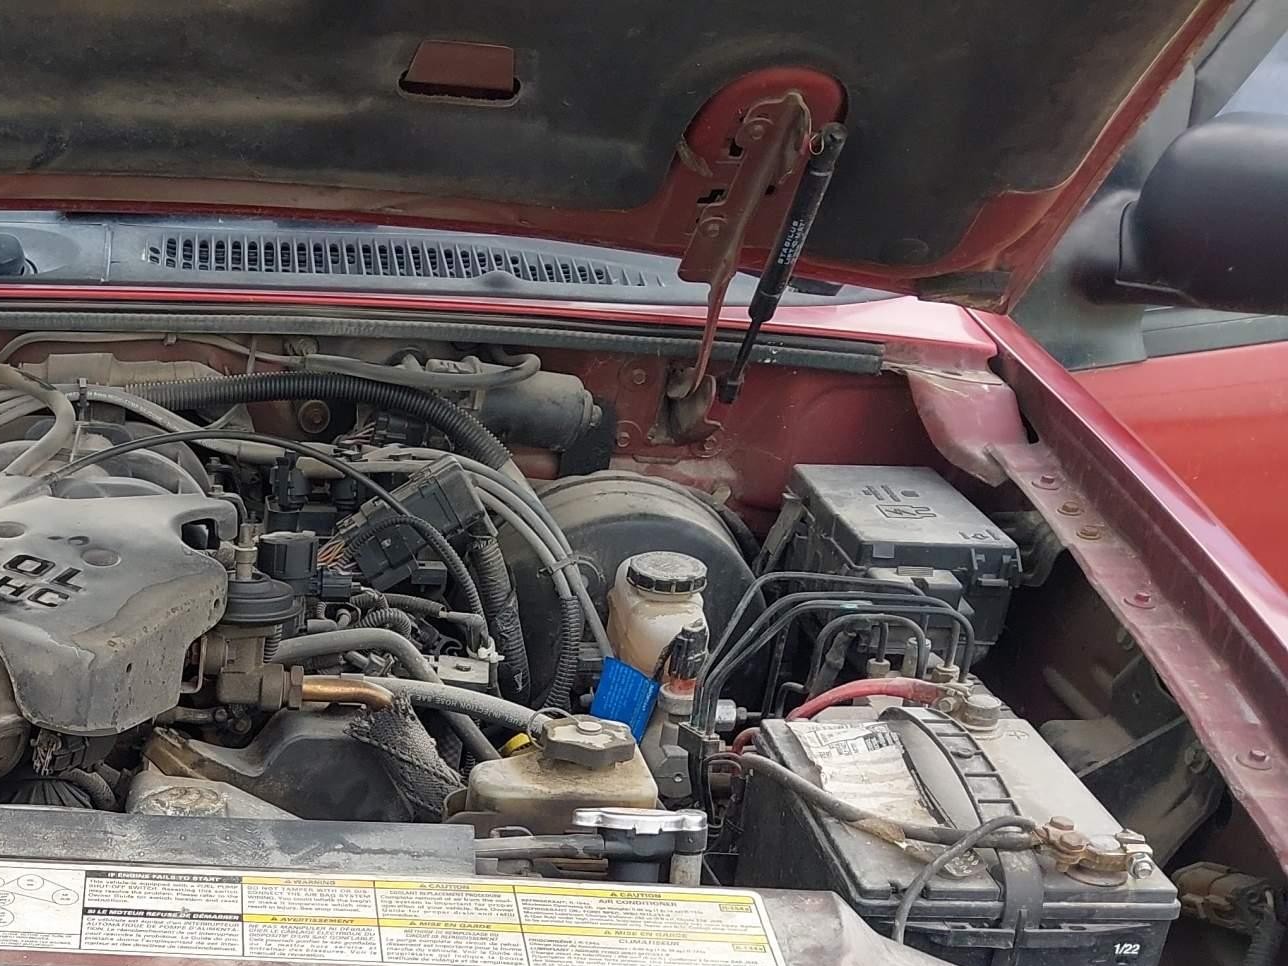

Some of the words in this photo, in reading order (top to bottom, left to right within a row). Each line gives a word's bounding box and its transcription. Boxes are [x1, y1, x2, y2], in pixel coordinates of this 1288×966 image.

[777, 220, 799, 264] STABILUS
[435, 696, 458, 708] HOSE
[460, 701, 502, 719] INJECTION
[1114, 943, 1140, 954] 1/22
